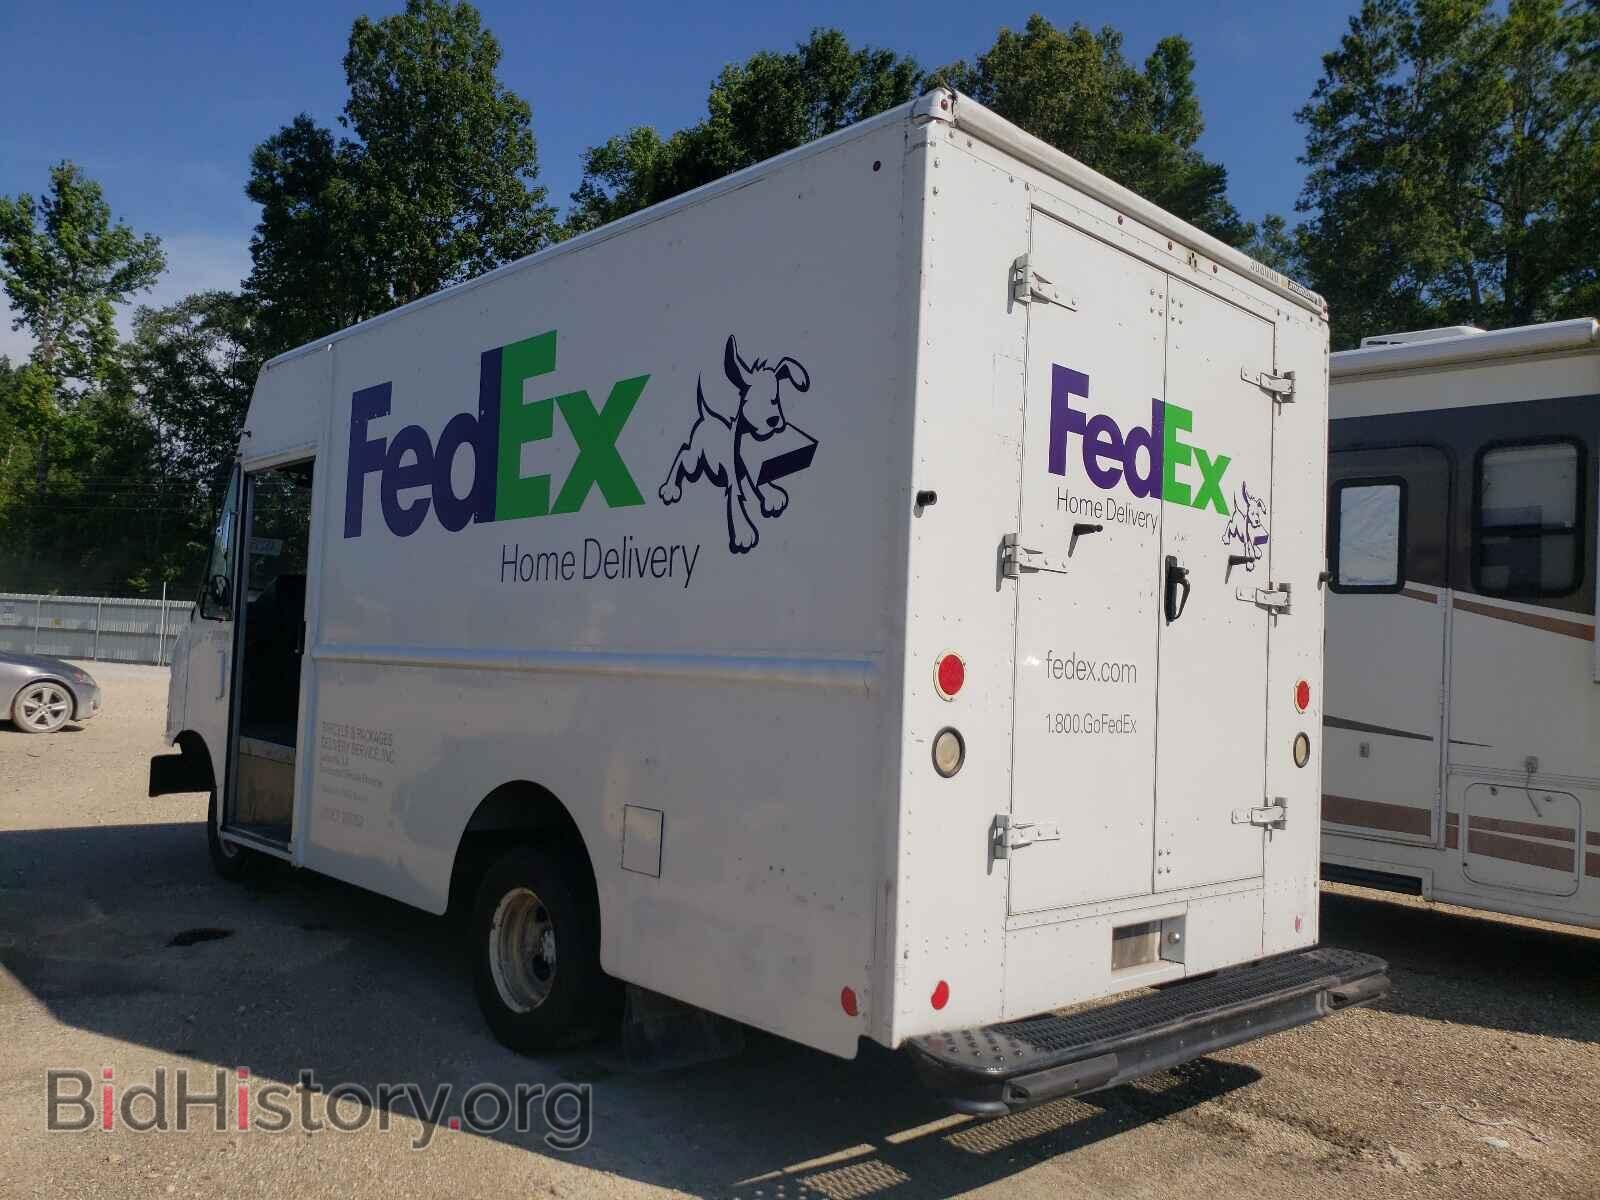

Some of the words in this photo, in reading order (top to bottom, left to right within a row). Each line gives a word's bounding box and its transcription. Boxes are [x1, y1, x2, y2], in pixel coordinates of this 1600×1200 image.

[344, 329, 651, 538] FedEx
[1048, 363, 1232, 517] FedEx
[1057, 487, 1103, 518] Home
[1106, 497, 1160, 537] Delivery
[501, 543, 576, 583] Home
[583, 535, 700, 588] Delivery
[1046, 649, 1137, 683] fedex.com
[1046, 712, 1137, 734] 1.800.GoFedEx
